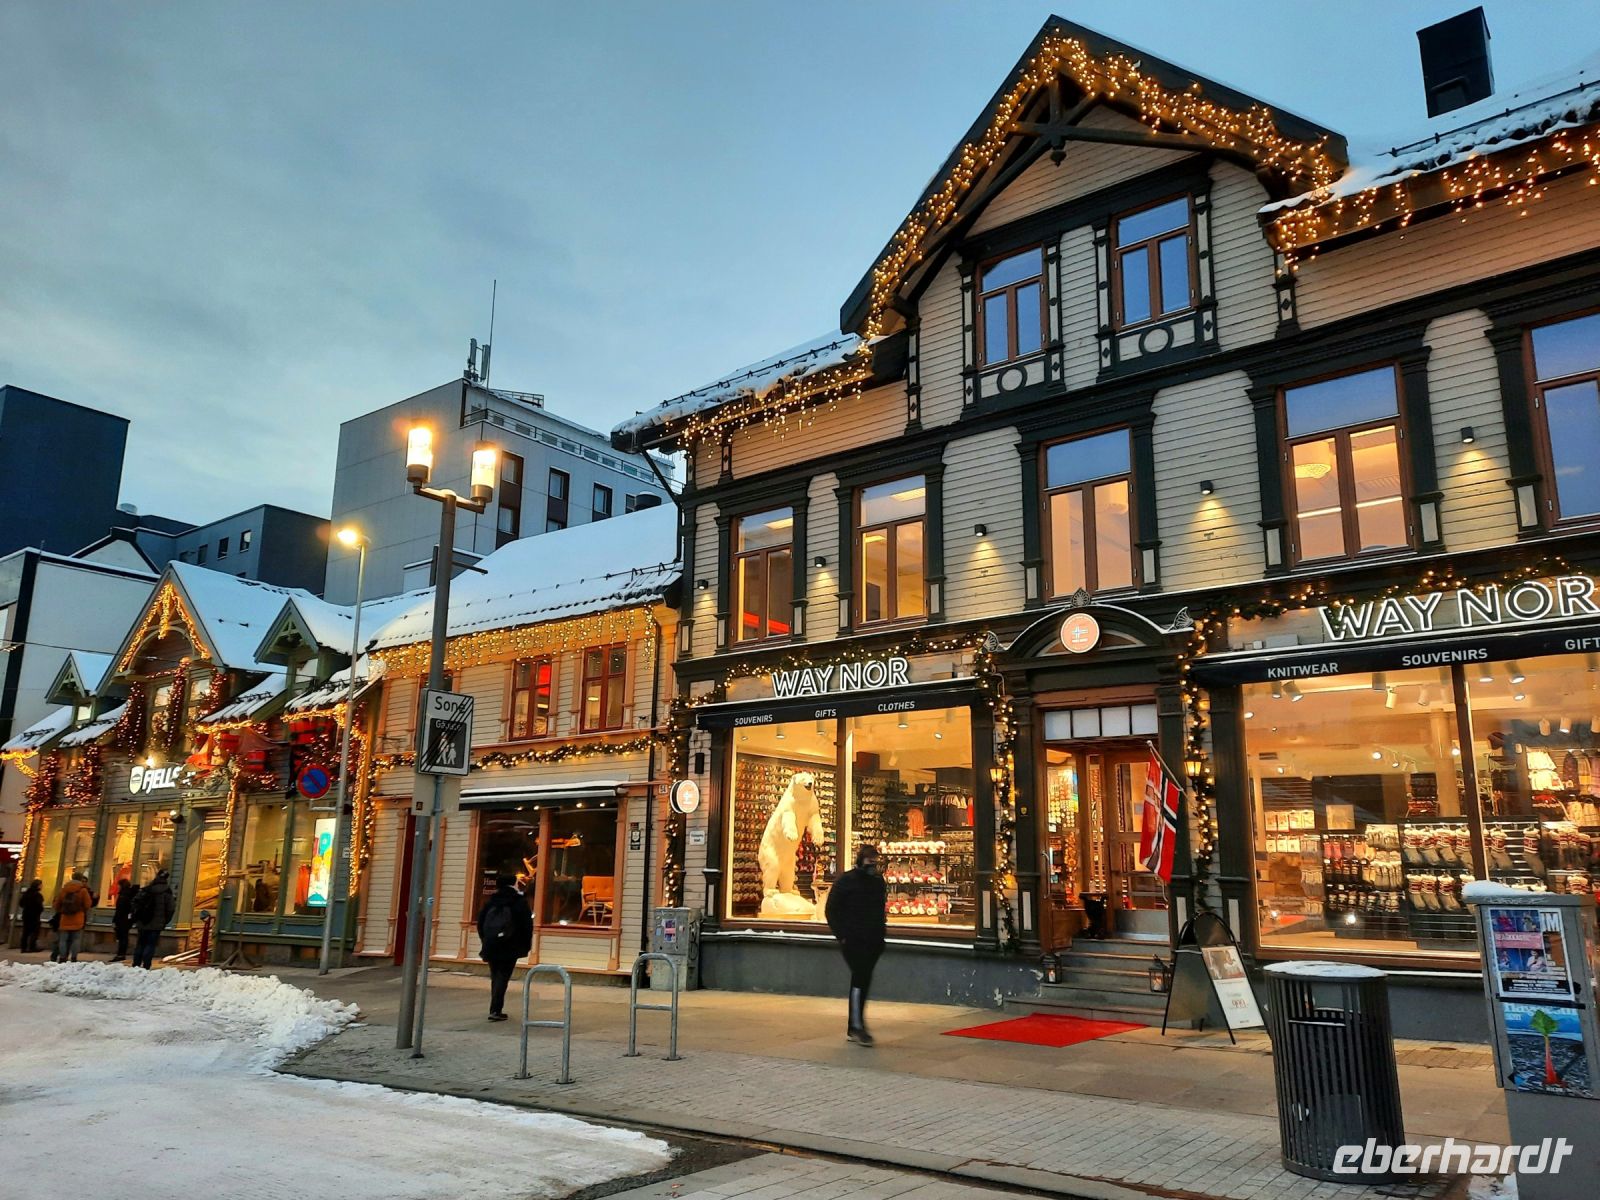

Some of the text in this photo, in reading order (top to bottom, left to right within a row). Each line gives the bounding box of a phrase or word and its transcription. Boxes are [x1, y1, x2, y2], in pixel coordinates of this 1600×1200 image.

[1318, 576, 1600, 641] WAY NOR
[771, 657, 909, 698] WAY NOR
[1267, 662, 1339, 678] KNITWEAR
[1401, 648, 1488, 667] SOUVENIRS
[434, 696, 465, 713] Sone
[734, 701, 915, 726] SOUVENIRS GIFTS CLOTHES
